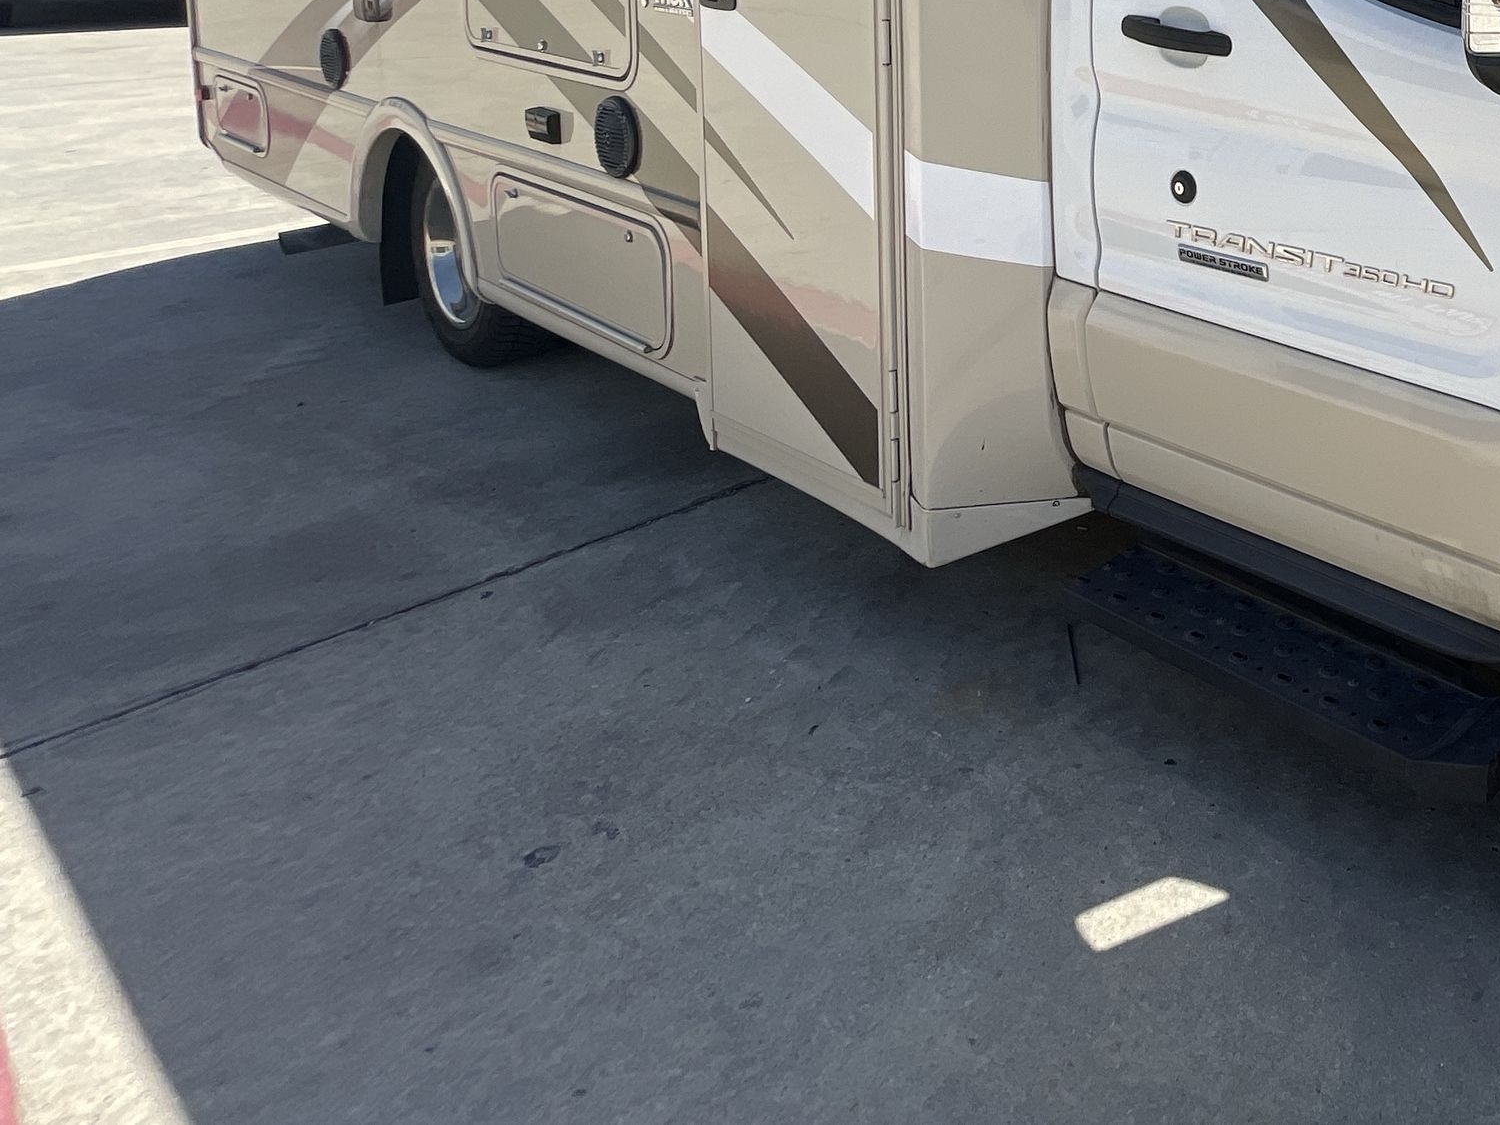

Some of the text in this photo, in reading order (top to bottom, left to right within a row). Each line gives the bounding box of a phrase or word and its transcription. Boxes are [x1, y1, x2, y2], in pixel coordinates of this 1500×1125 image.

[1166, 219, 1345, 273] TRANSIT
[1179, 247, 1264, 276] POWER STROKE
